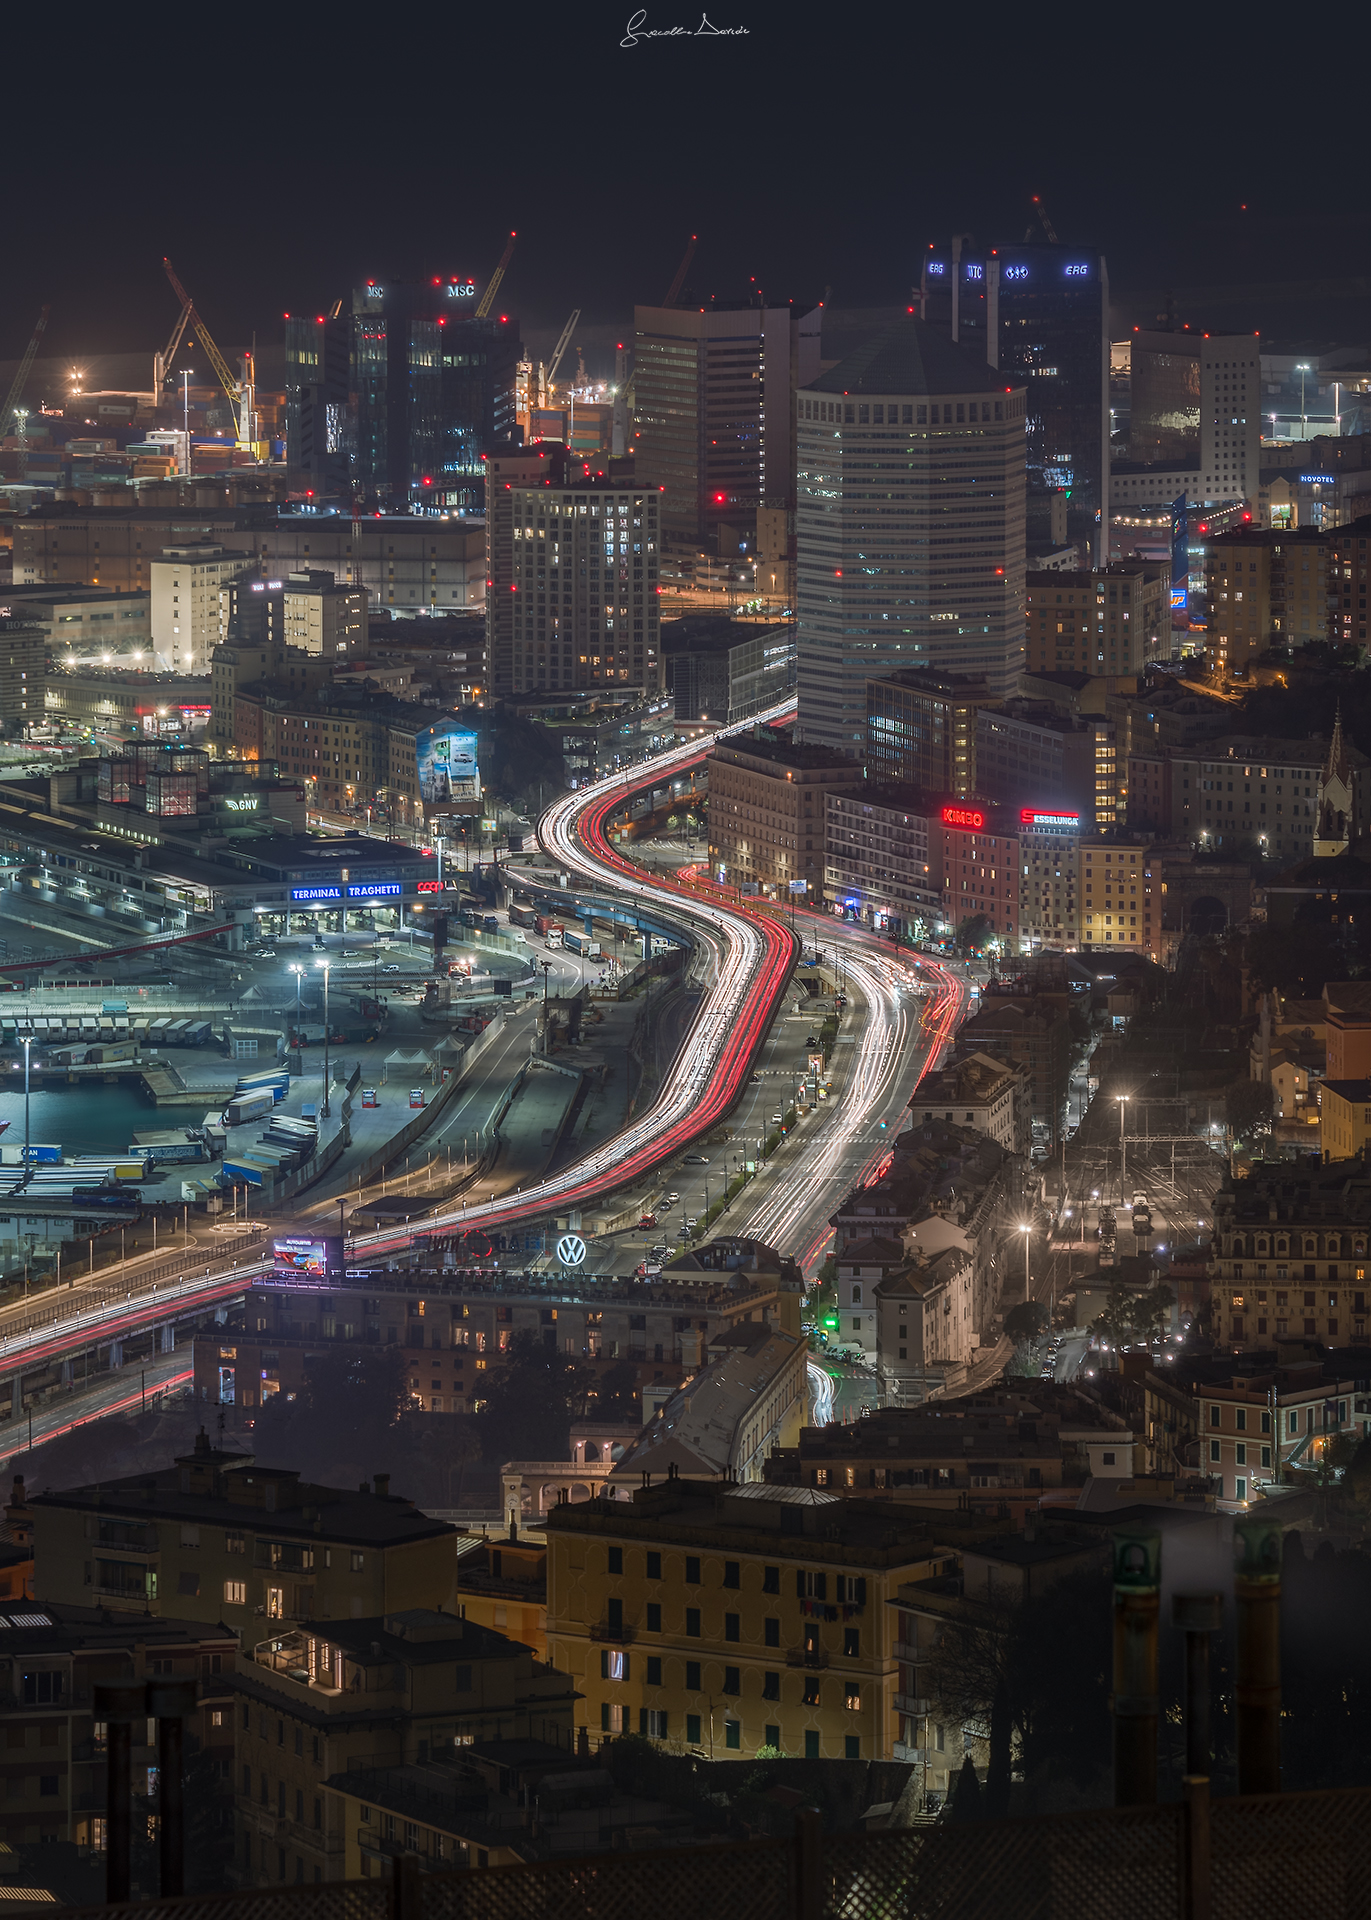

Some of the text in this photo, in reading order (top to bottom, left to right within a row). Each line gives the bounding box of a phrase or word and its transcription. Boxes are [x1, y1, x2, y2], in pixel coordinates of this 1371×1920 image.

[929, 263, 944, 274] ERG
[1065, 265, 1088, 275] ERG
[368, 286, 383, 298] MSC
[448, 285, 474, 297] MSC
[6, 620, 40, 630] HOTEL
[239, 800, 258, 810] GNV
[943, 809, 982, 827] KIMBO
[293, 885, 400, 899] TERMINAL TRAGHETTI
[1263, 1308, 1333, 1316] MIRAMARE
